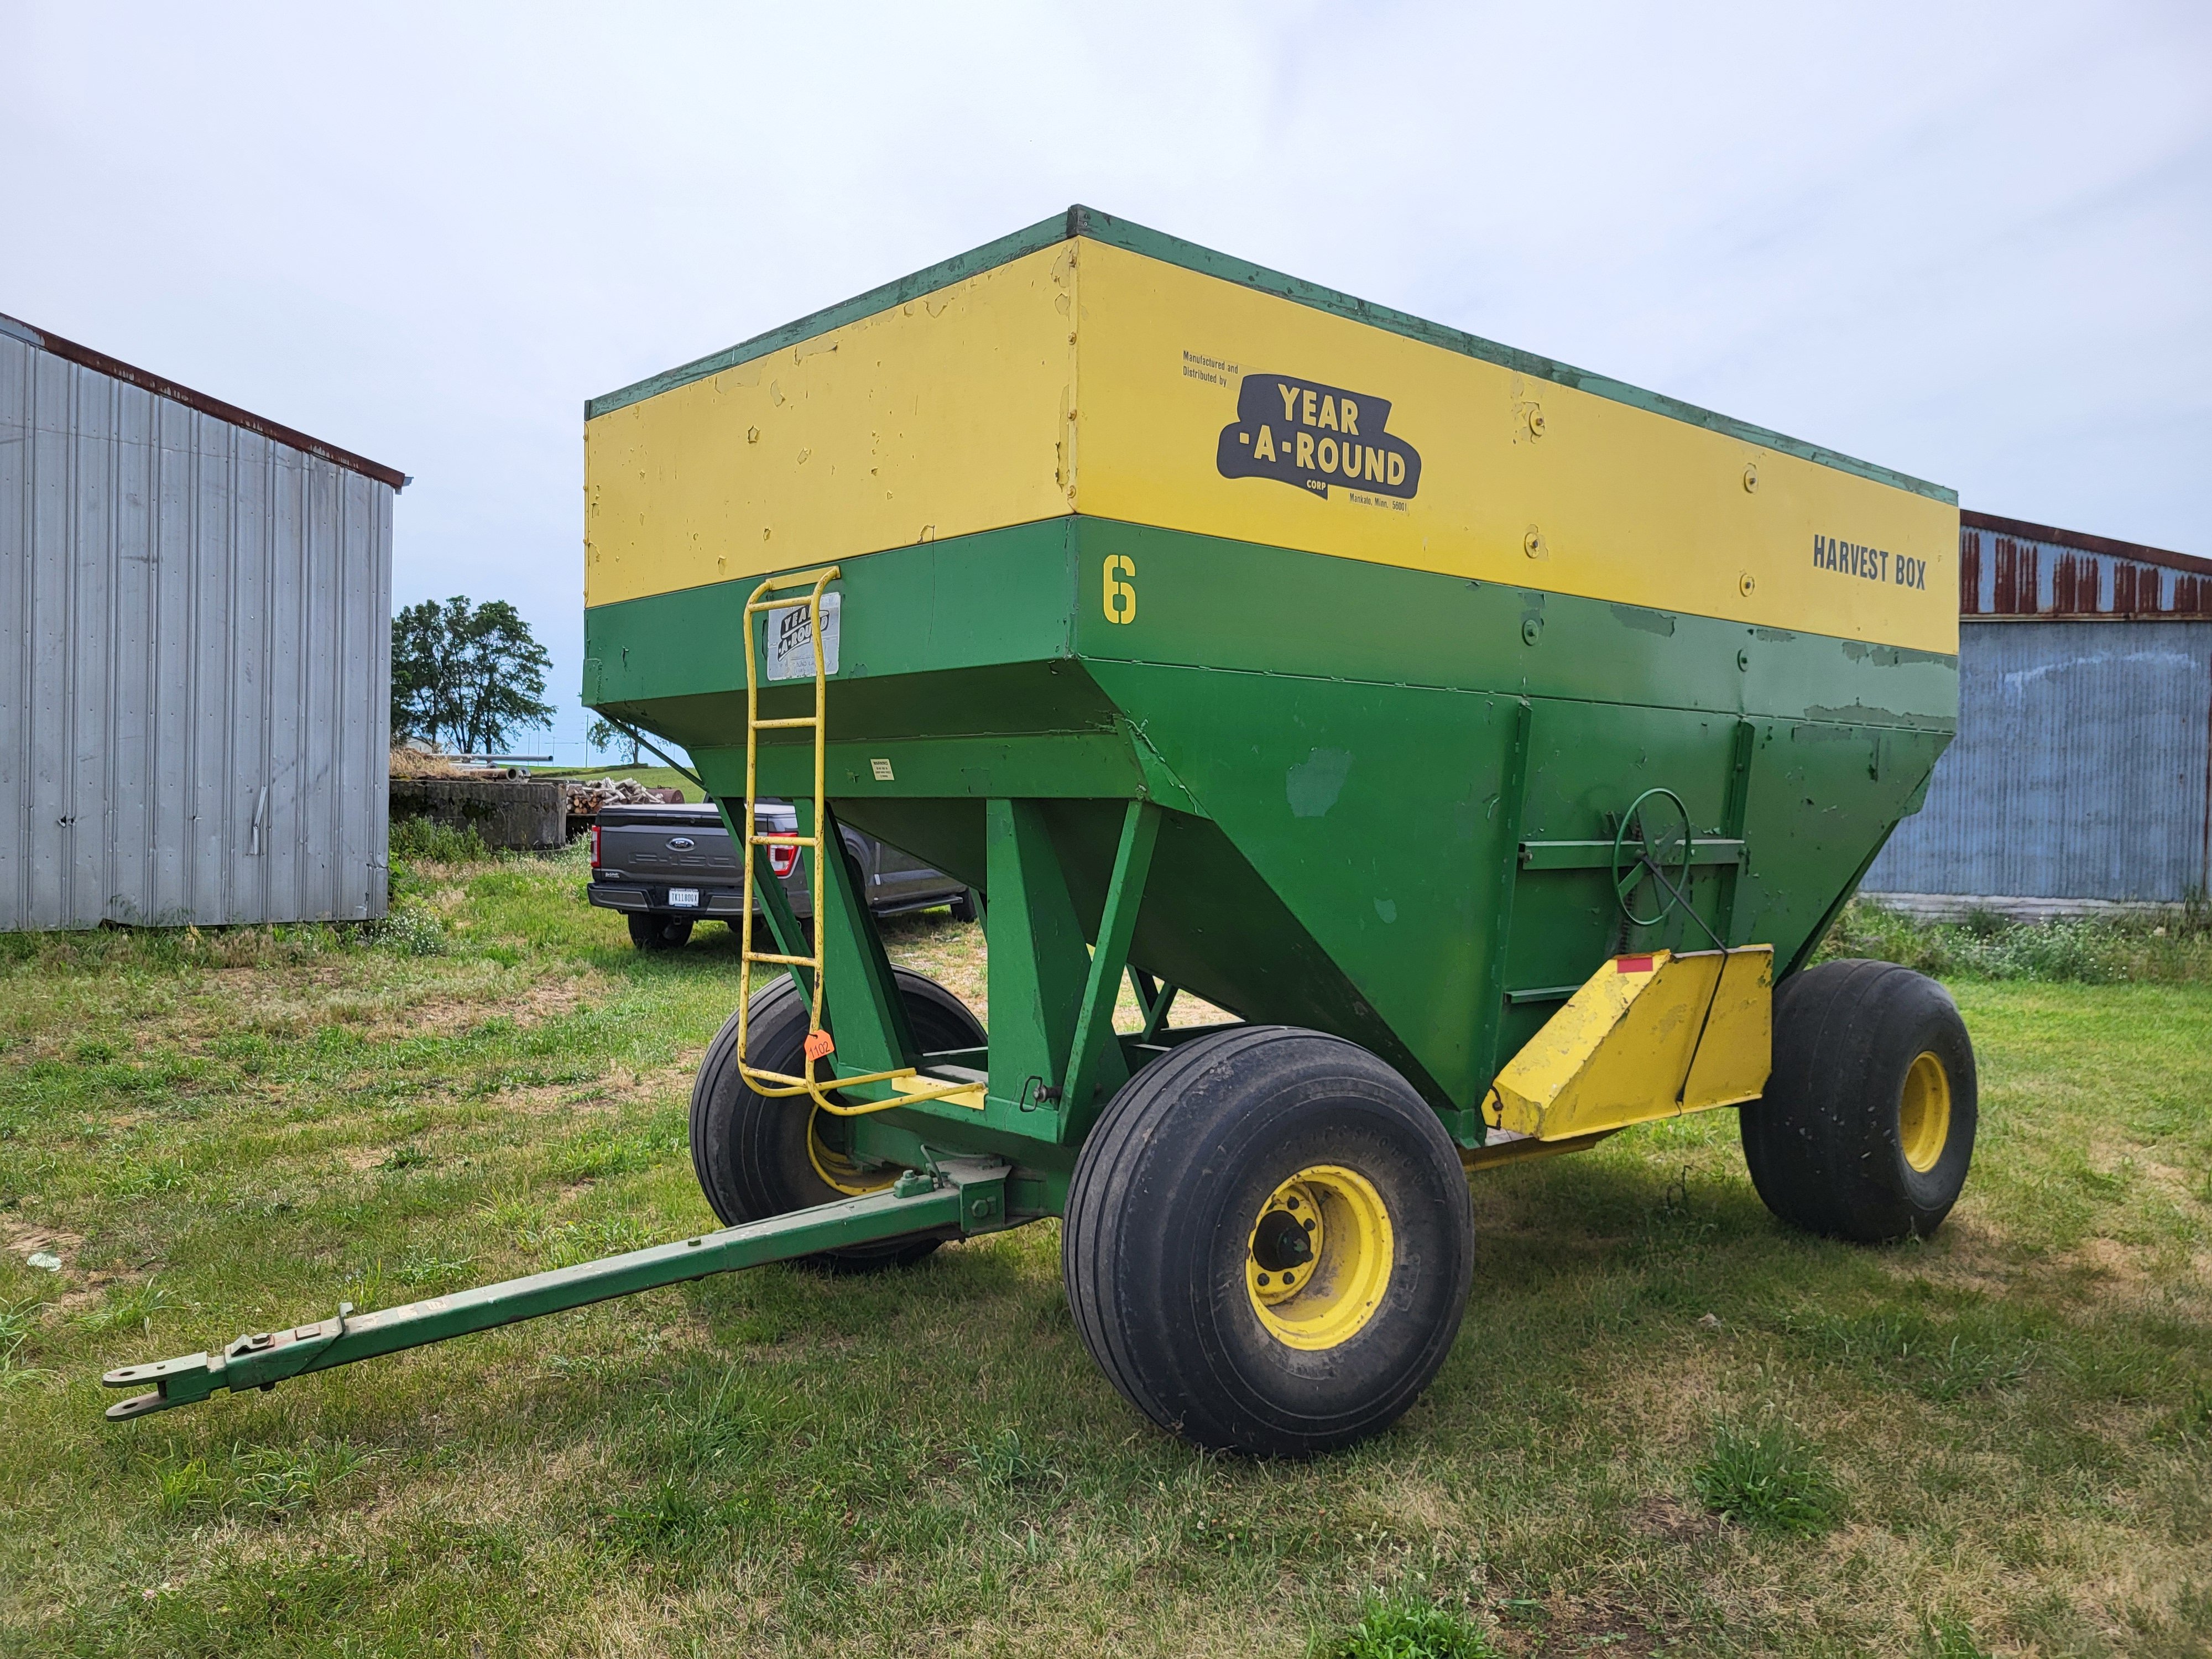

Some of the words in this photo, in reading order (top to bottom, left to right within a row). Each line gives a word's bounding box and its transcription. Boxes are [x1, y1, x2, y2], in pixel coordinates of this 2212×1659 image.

[1183, 350, 1225, 371] Manufactured
[1227, 364, 1238, 374] and
[1183, 366, 1217, 384] Distributed
[1219, 376, 1227, 387] by
[1277, 383, 1359, 436] YEAR
[1306, 479, 1326, 491] CORP
[1349, 493, 1373, 507] Mankato,
[1374, 498, 1389, 509] Minn.
[1392, 500, 1407, 512] 56001
[1813, 534, 1888, 582] HARVEST
[1896, 554, 1926, 590] BOX
[1103, 554, 1136, 624] 6
[784, 607, 813, 631] YEA
[629, 853, 736, 868] F-150
[809, 1041, 831, 1058] 1102
